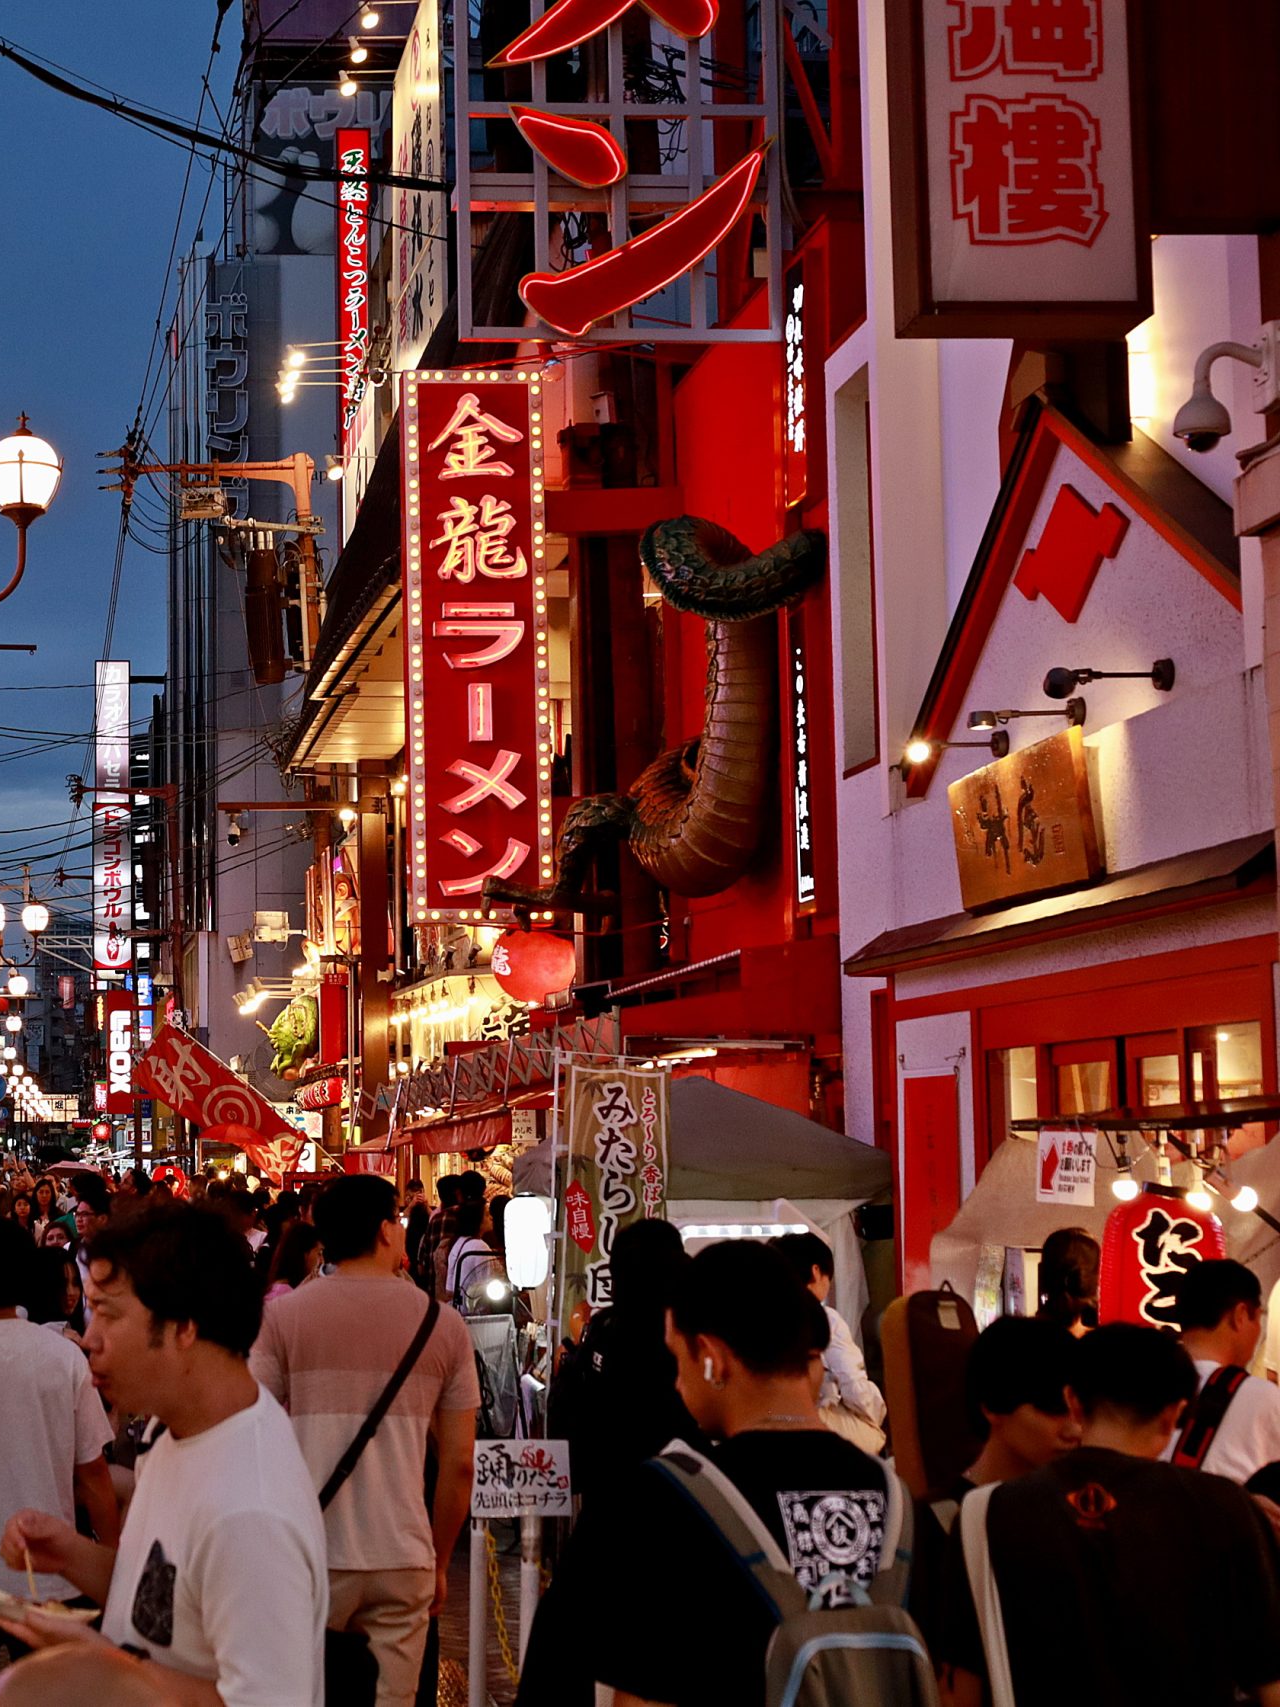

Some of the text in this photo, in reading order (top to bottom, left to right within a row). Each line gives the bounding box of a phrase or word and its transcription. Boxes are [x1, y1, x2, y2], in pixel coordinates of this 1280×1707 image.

[426, 391, 530, 897] 金龍ラーメン
[103, 810, 123, 918] ドラゴンボウル
[147, 1037, 211, 1110] 射
[565, 1192, 593, 1240] 味自慢
[473, 1490, 568, 1509] 先頭はコチラ
